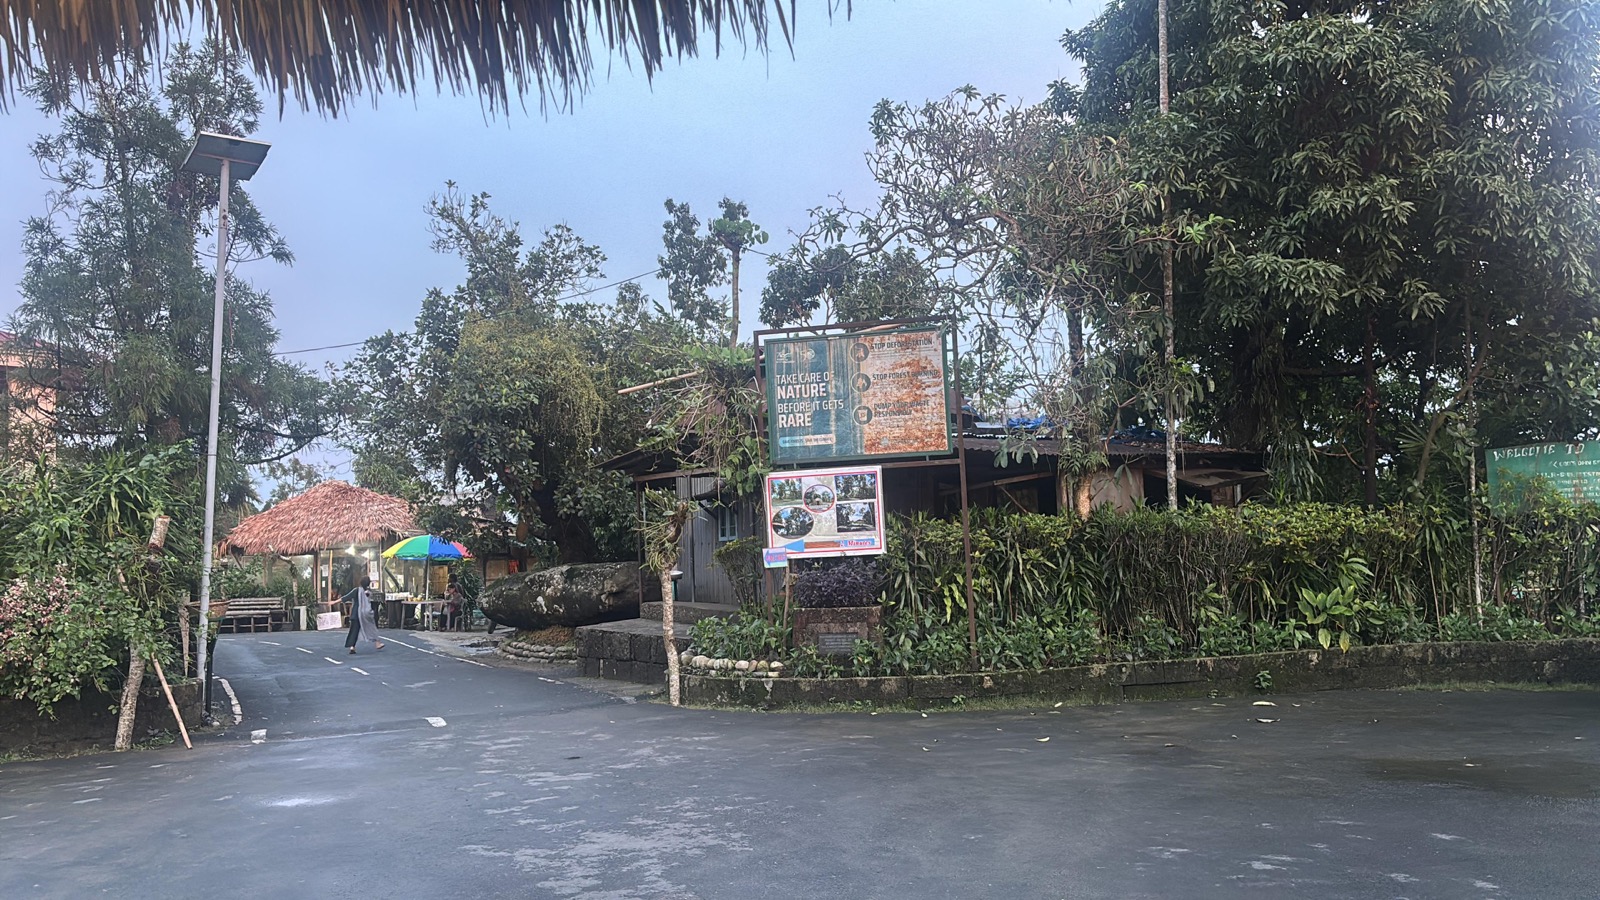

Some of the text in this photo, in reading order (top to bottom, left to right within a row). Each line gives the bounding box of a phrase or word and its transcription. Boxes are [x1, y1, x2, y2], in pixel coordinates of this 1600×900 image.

[776, 374, 798, 384] TAKE
[799, 372, 822, 384] CARE
[778, 382, 827, 400] NATURE
[778, 400, 844, 414] BEFORE IT GETS
[778, 413, 812, 428] RARE
[1565, 443, 1585, 454] TO
